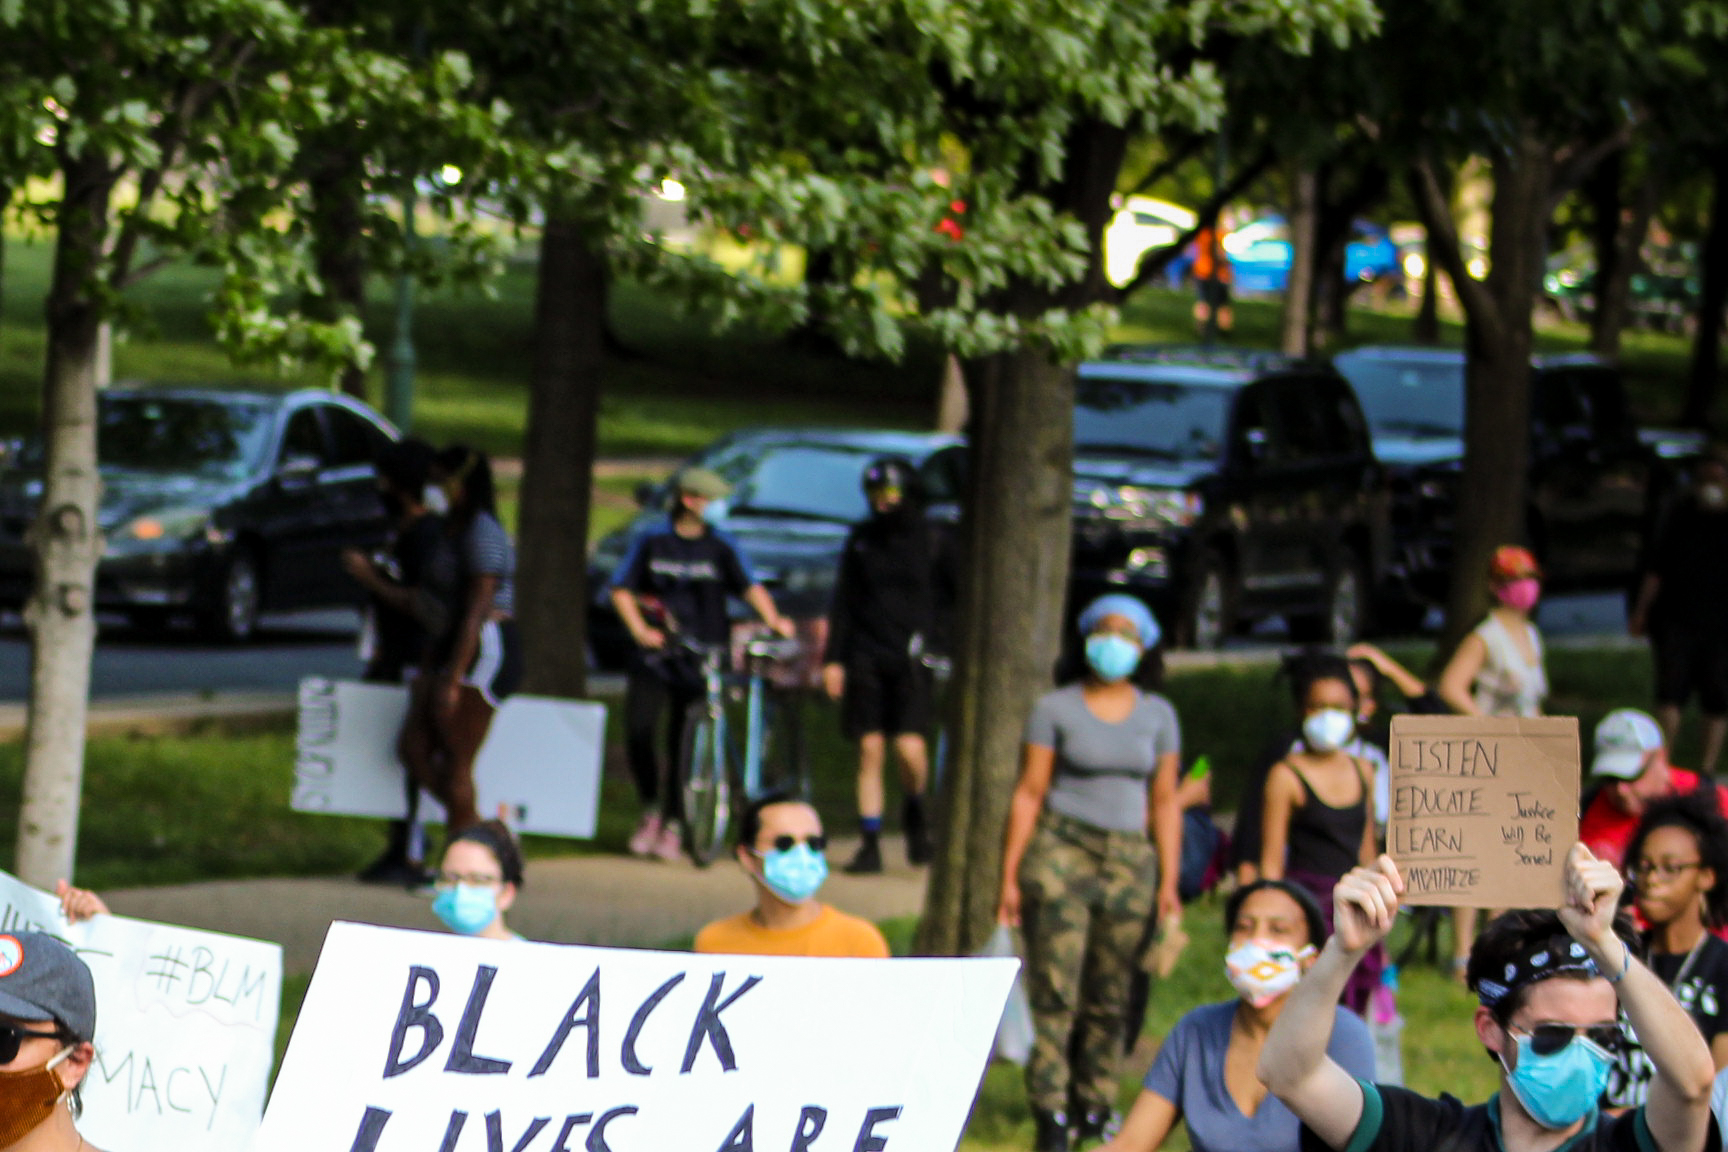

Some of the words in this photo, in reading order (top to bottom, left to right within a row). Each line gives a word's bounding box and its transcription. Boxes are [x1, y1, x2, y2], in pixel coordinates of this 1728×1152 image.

[1398, 739, 1498, 777] LISTEN
[1394, 785, 1485, 819] EDUCATE
[1395, 826, 1462, 854] LEARN
[146, 944, 268, 1022] #BLM
[383, 964, 763, 1080] BLACK
